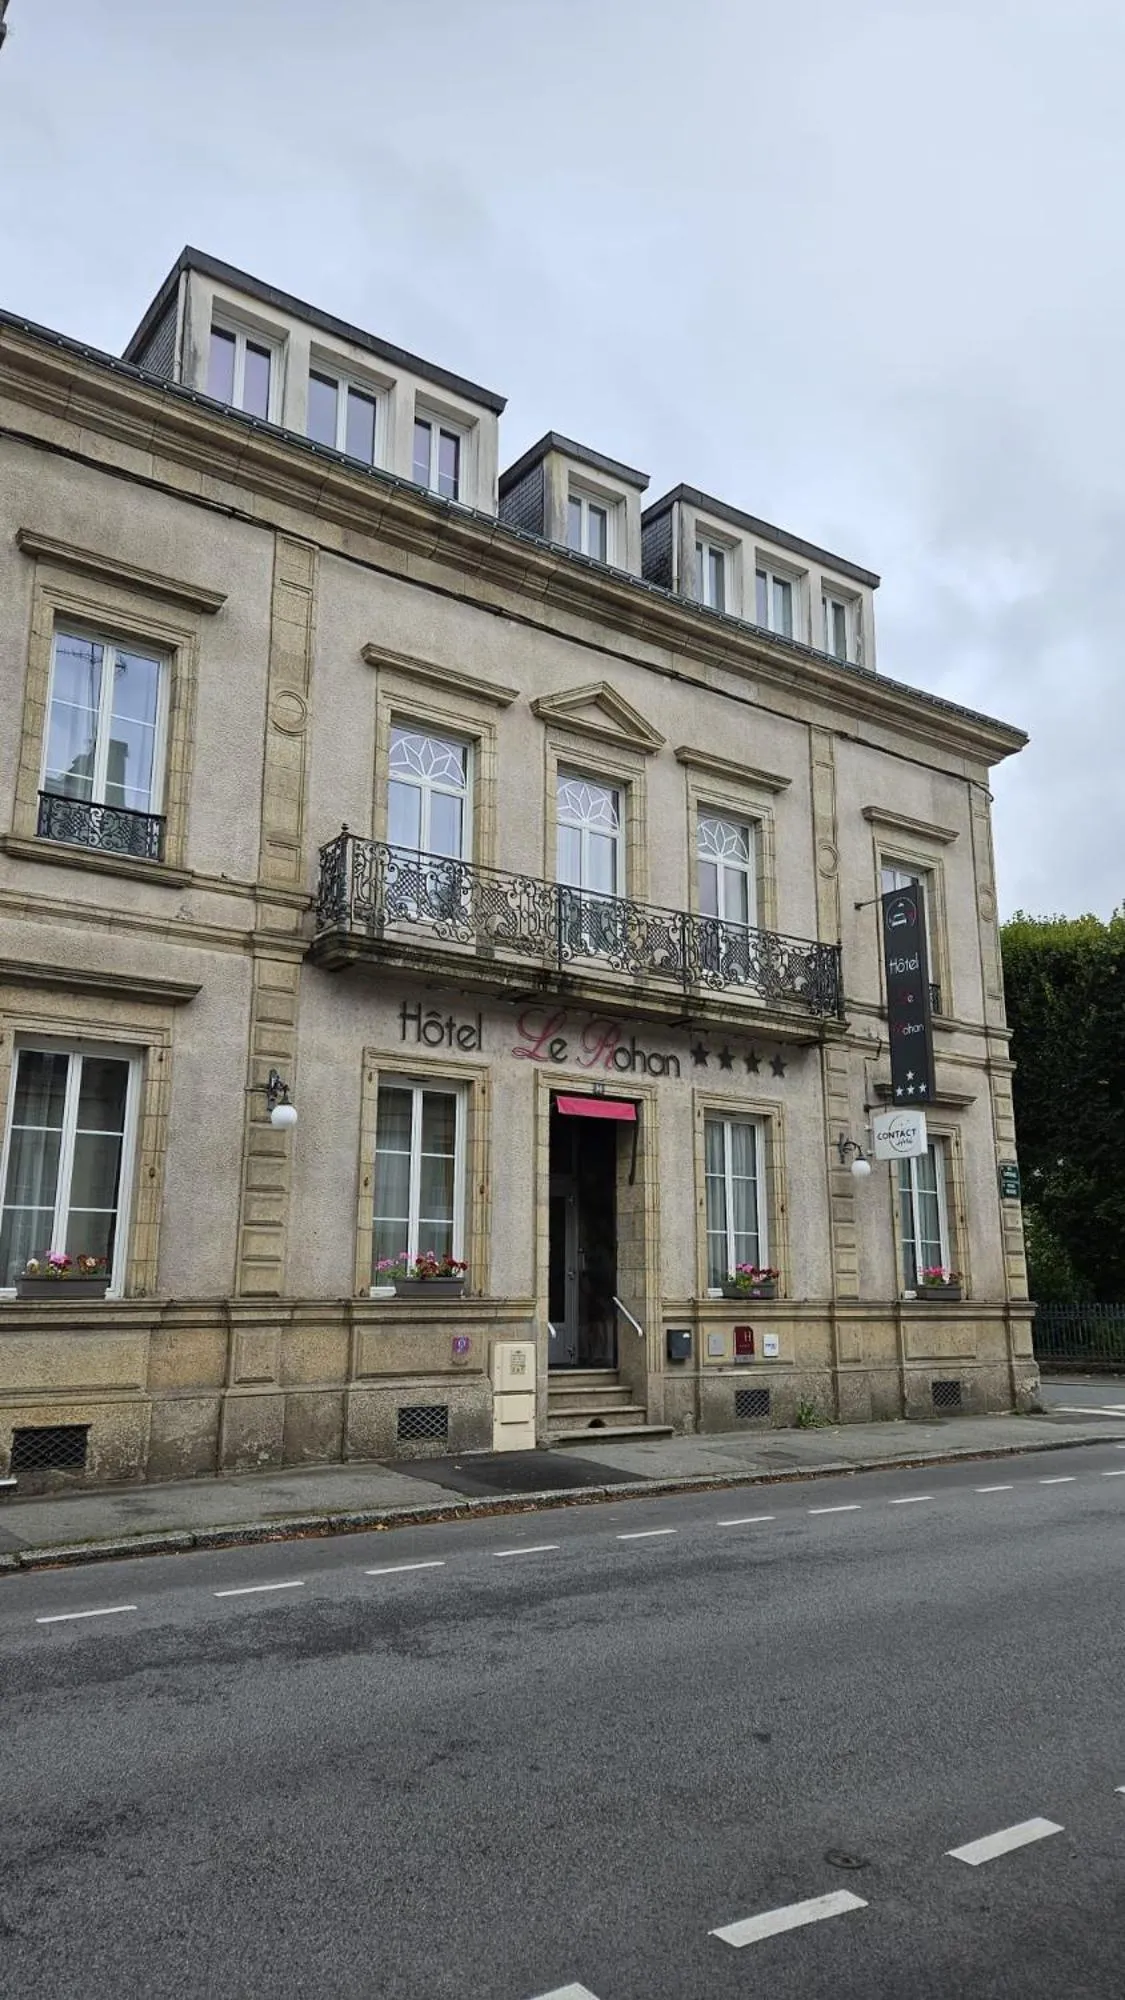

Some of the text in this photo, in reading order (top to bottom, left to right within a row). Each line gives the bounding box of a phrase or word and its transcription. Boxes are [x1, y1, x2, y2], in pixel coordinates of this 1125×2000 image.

[889, 951, 919, 975] Hôtel
[399, 1000, 680, 1078] Hôtel Le Rohan
[876, 1127, 917, 1141] CONTACT
